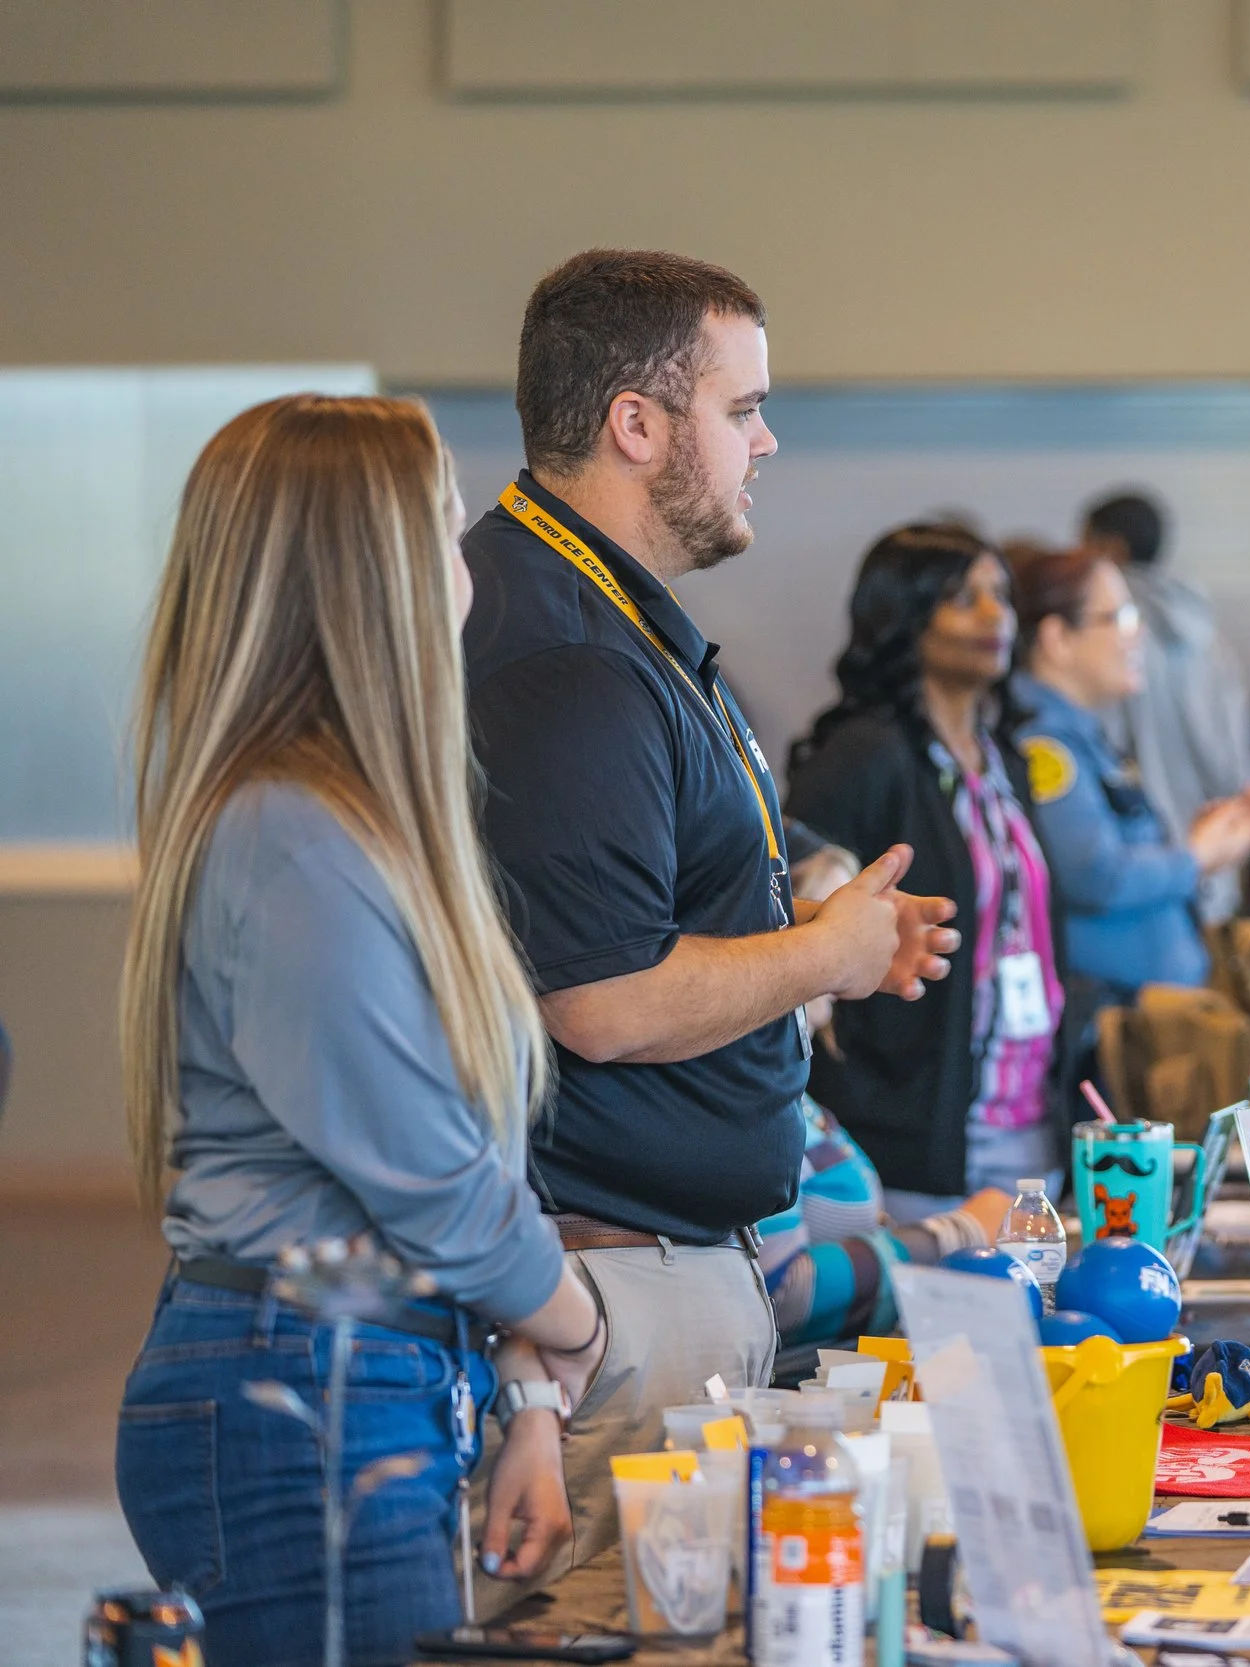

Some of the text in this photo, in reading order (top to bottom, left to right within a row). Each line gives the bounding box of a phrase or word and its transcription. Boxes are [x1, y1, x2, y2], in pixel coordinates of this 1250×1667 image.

[531, 515, 629, 606] FORD ICE CENTER
